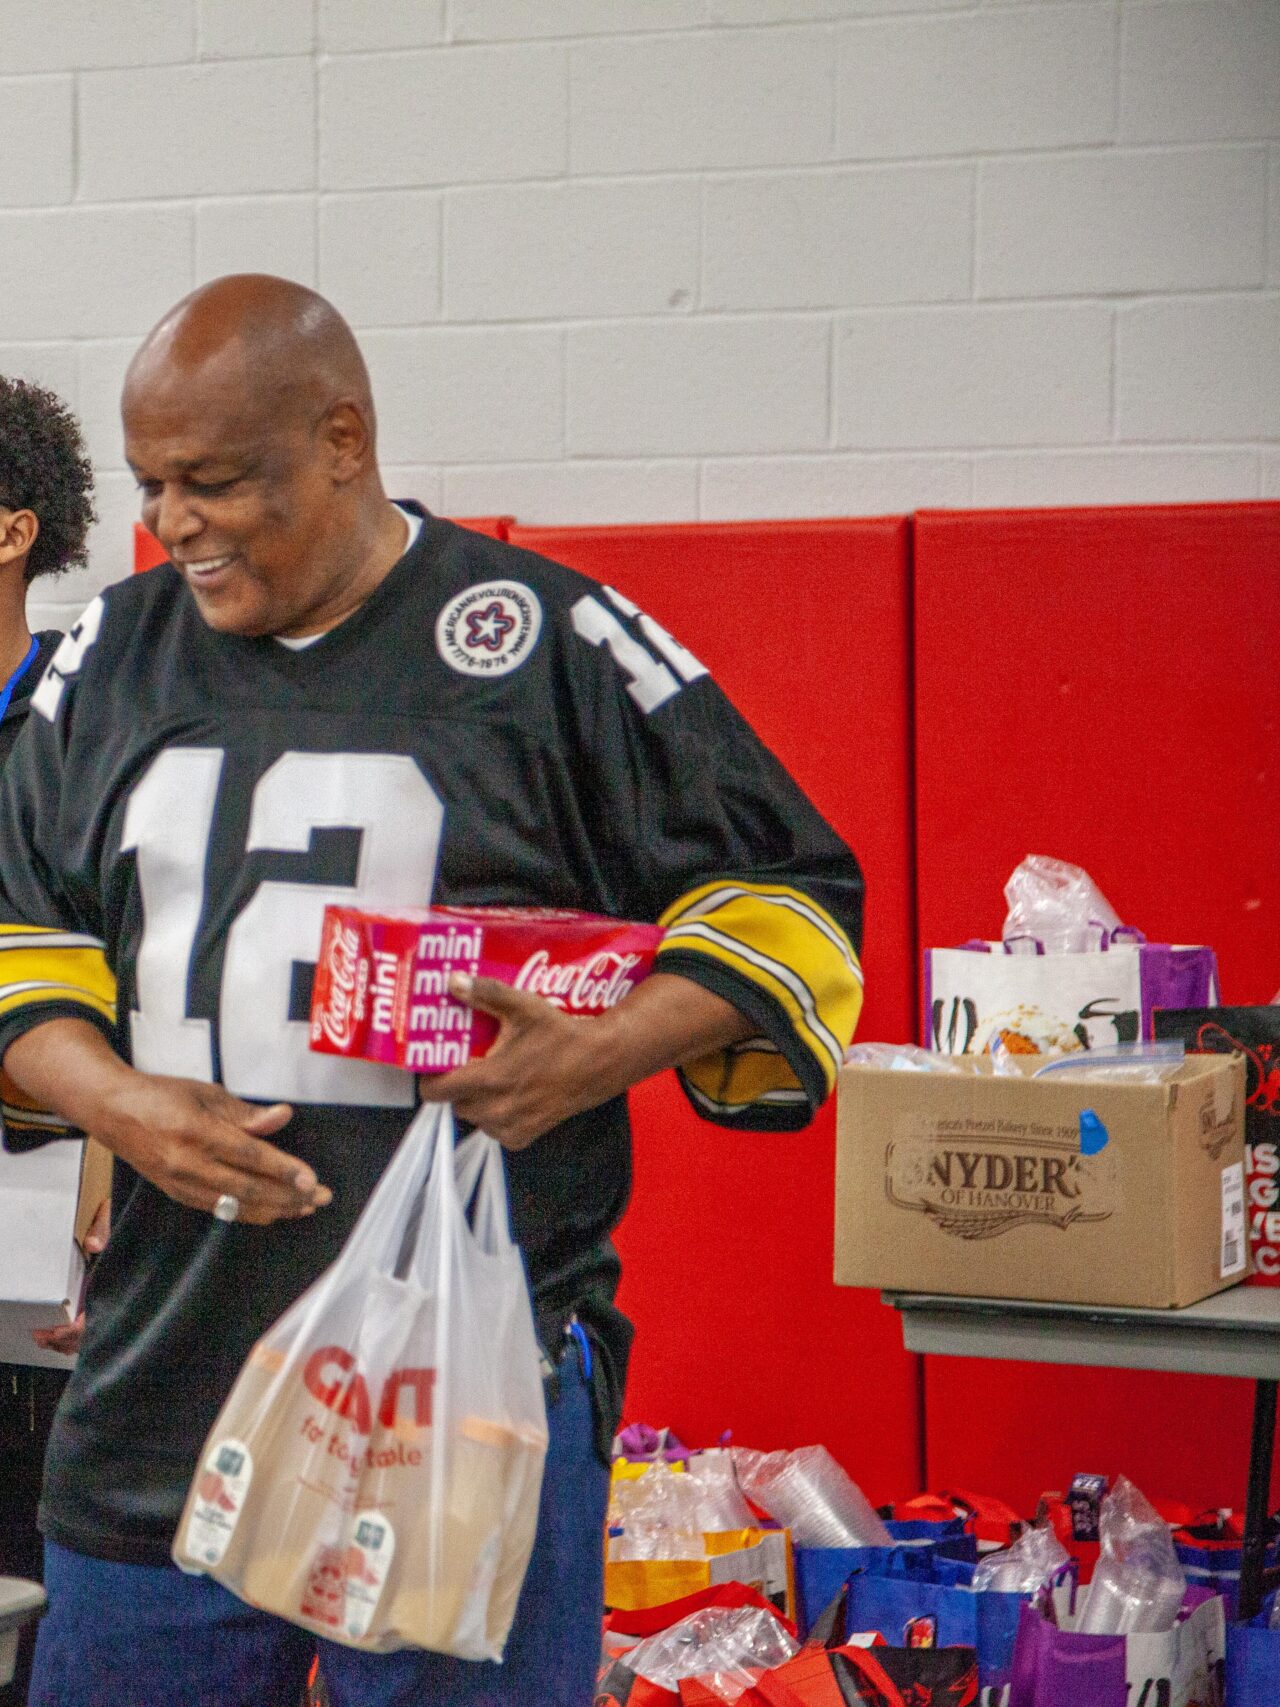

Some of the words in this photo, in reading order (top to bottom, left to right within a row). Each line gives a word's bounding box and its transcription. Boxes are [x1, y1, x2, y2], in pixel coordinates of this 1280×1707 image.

[445, 602, 468, 646] AMERICAN
[452, 649, 508, 669] 1776-1976
[120, 747, 445, 1108] 12
[420, 927, 482, 960] mini
[369, 950, 398, 1034] mini
[409, 1000, 472, 1032] mini
[406, 1034, 470, 1068] mini
[927, 1150, 1081, 1200] NYDER'
[941, 1188, 961, 1205] OF
[969, 1190, 1056, 1210] HANOVER
